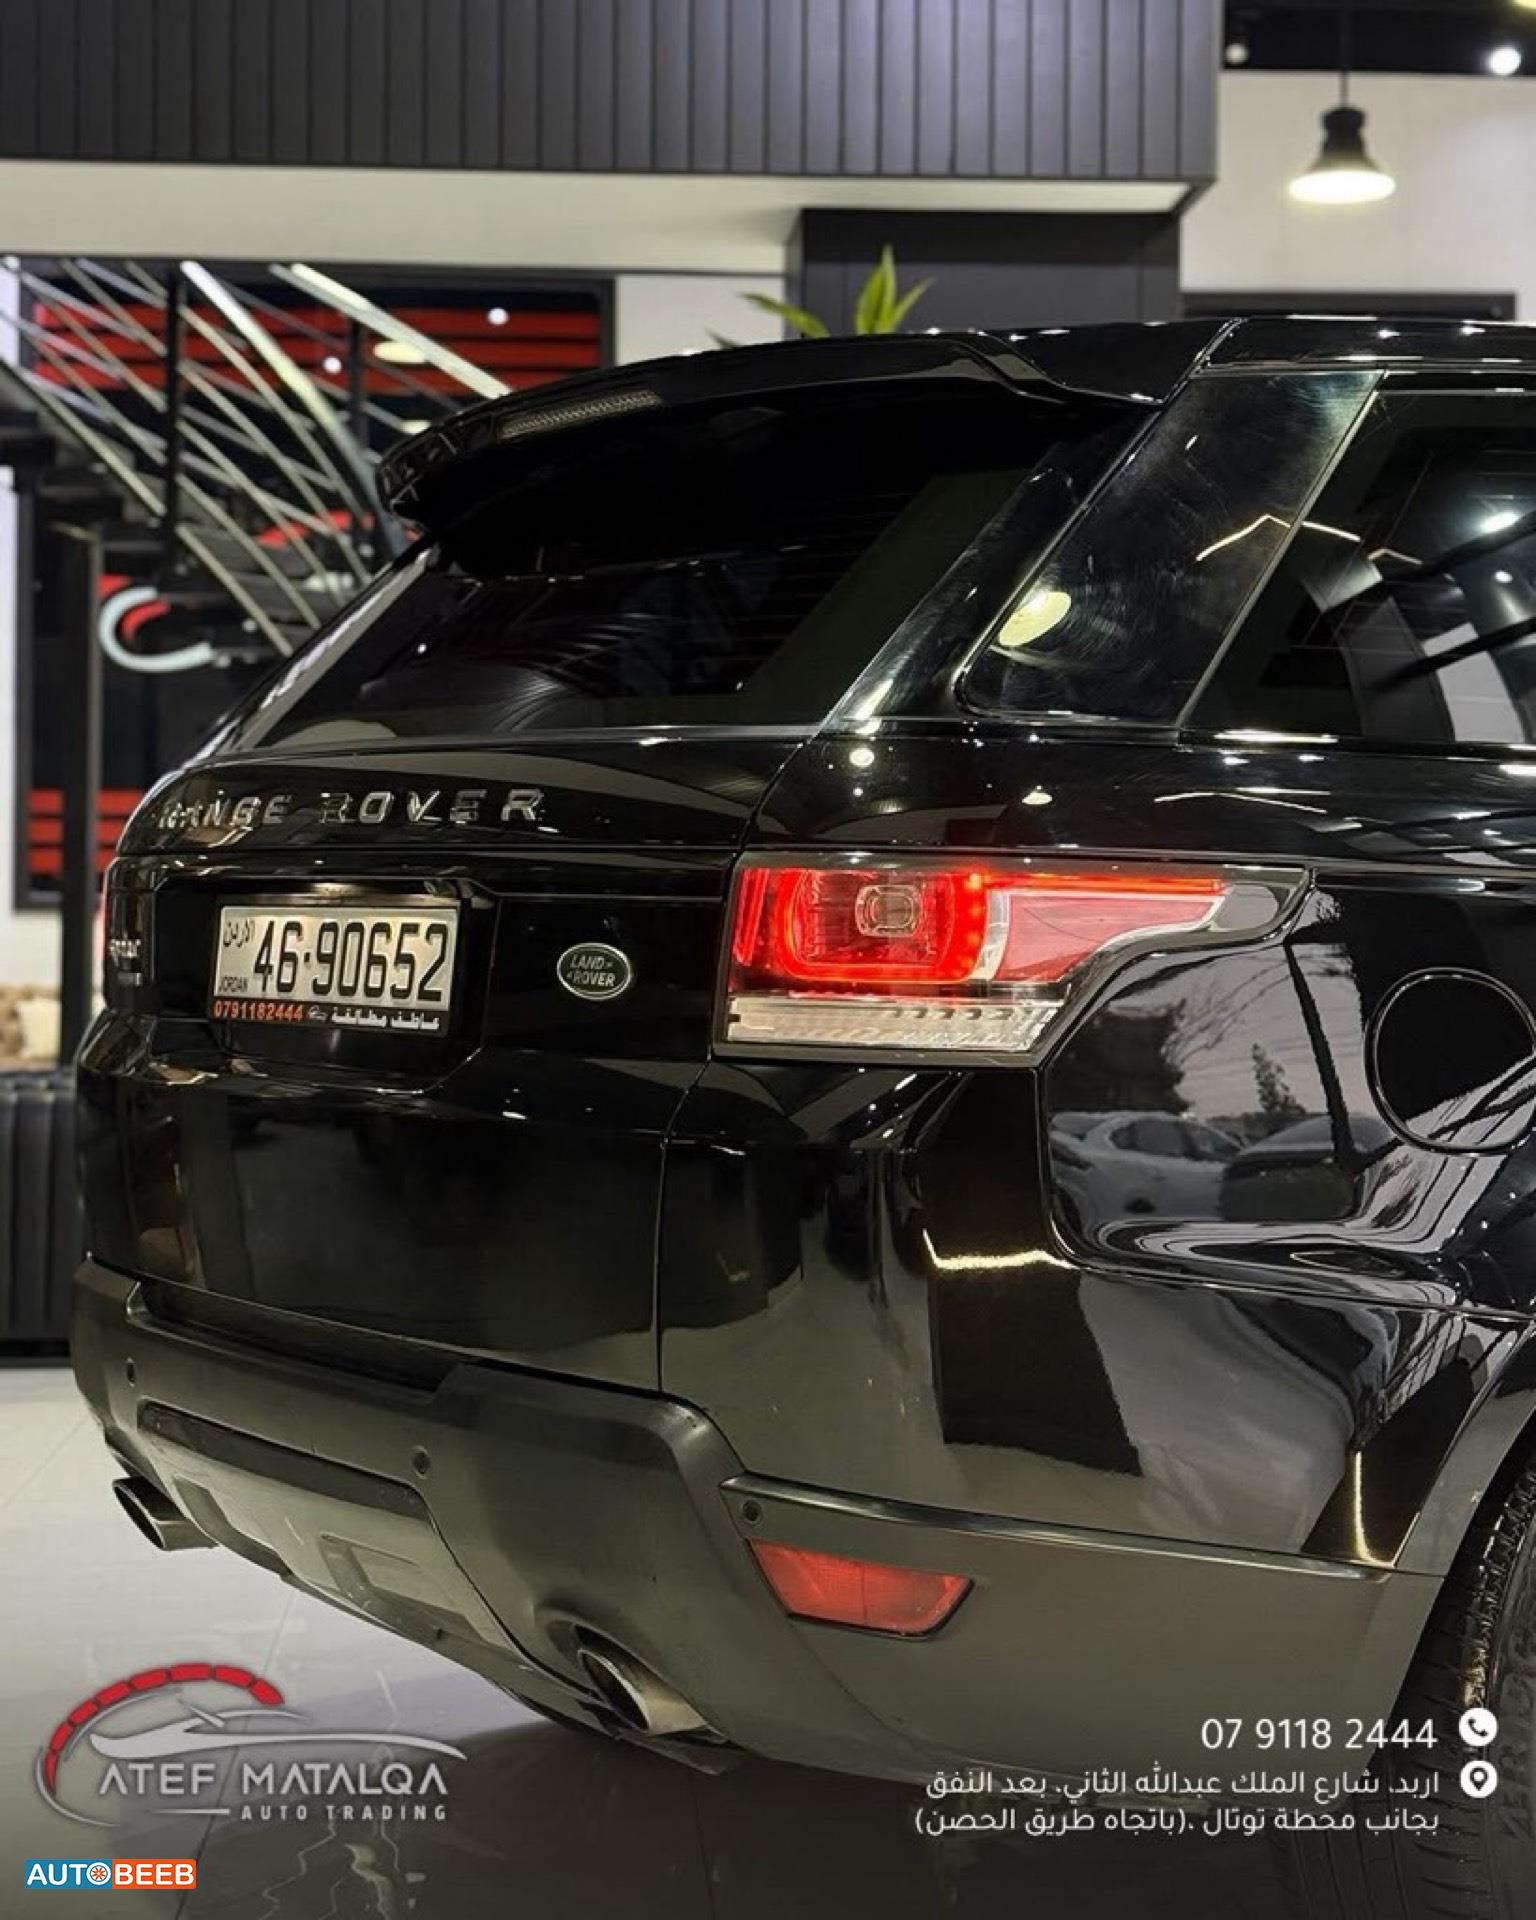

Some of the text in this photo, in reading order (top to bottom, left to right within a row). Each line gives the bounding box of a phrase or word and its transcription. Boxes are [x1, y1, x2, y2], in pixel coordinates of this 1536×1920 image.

[318, 789, 541, 824] ROVER
[573, 971, 616, 986] ROVER
[214, 1001, 303, 1021] 0791182444
